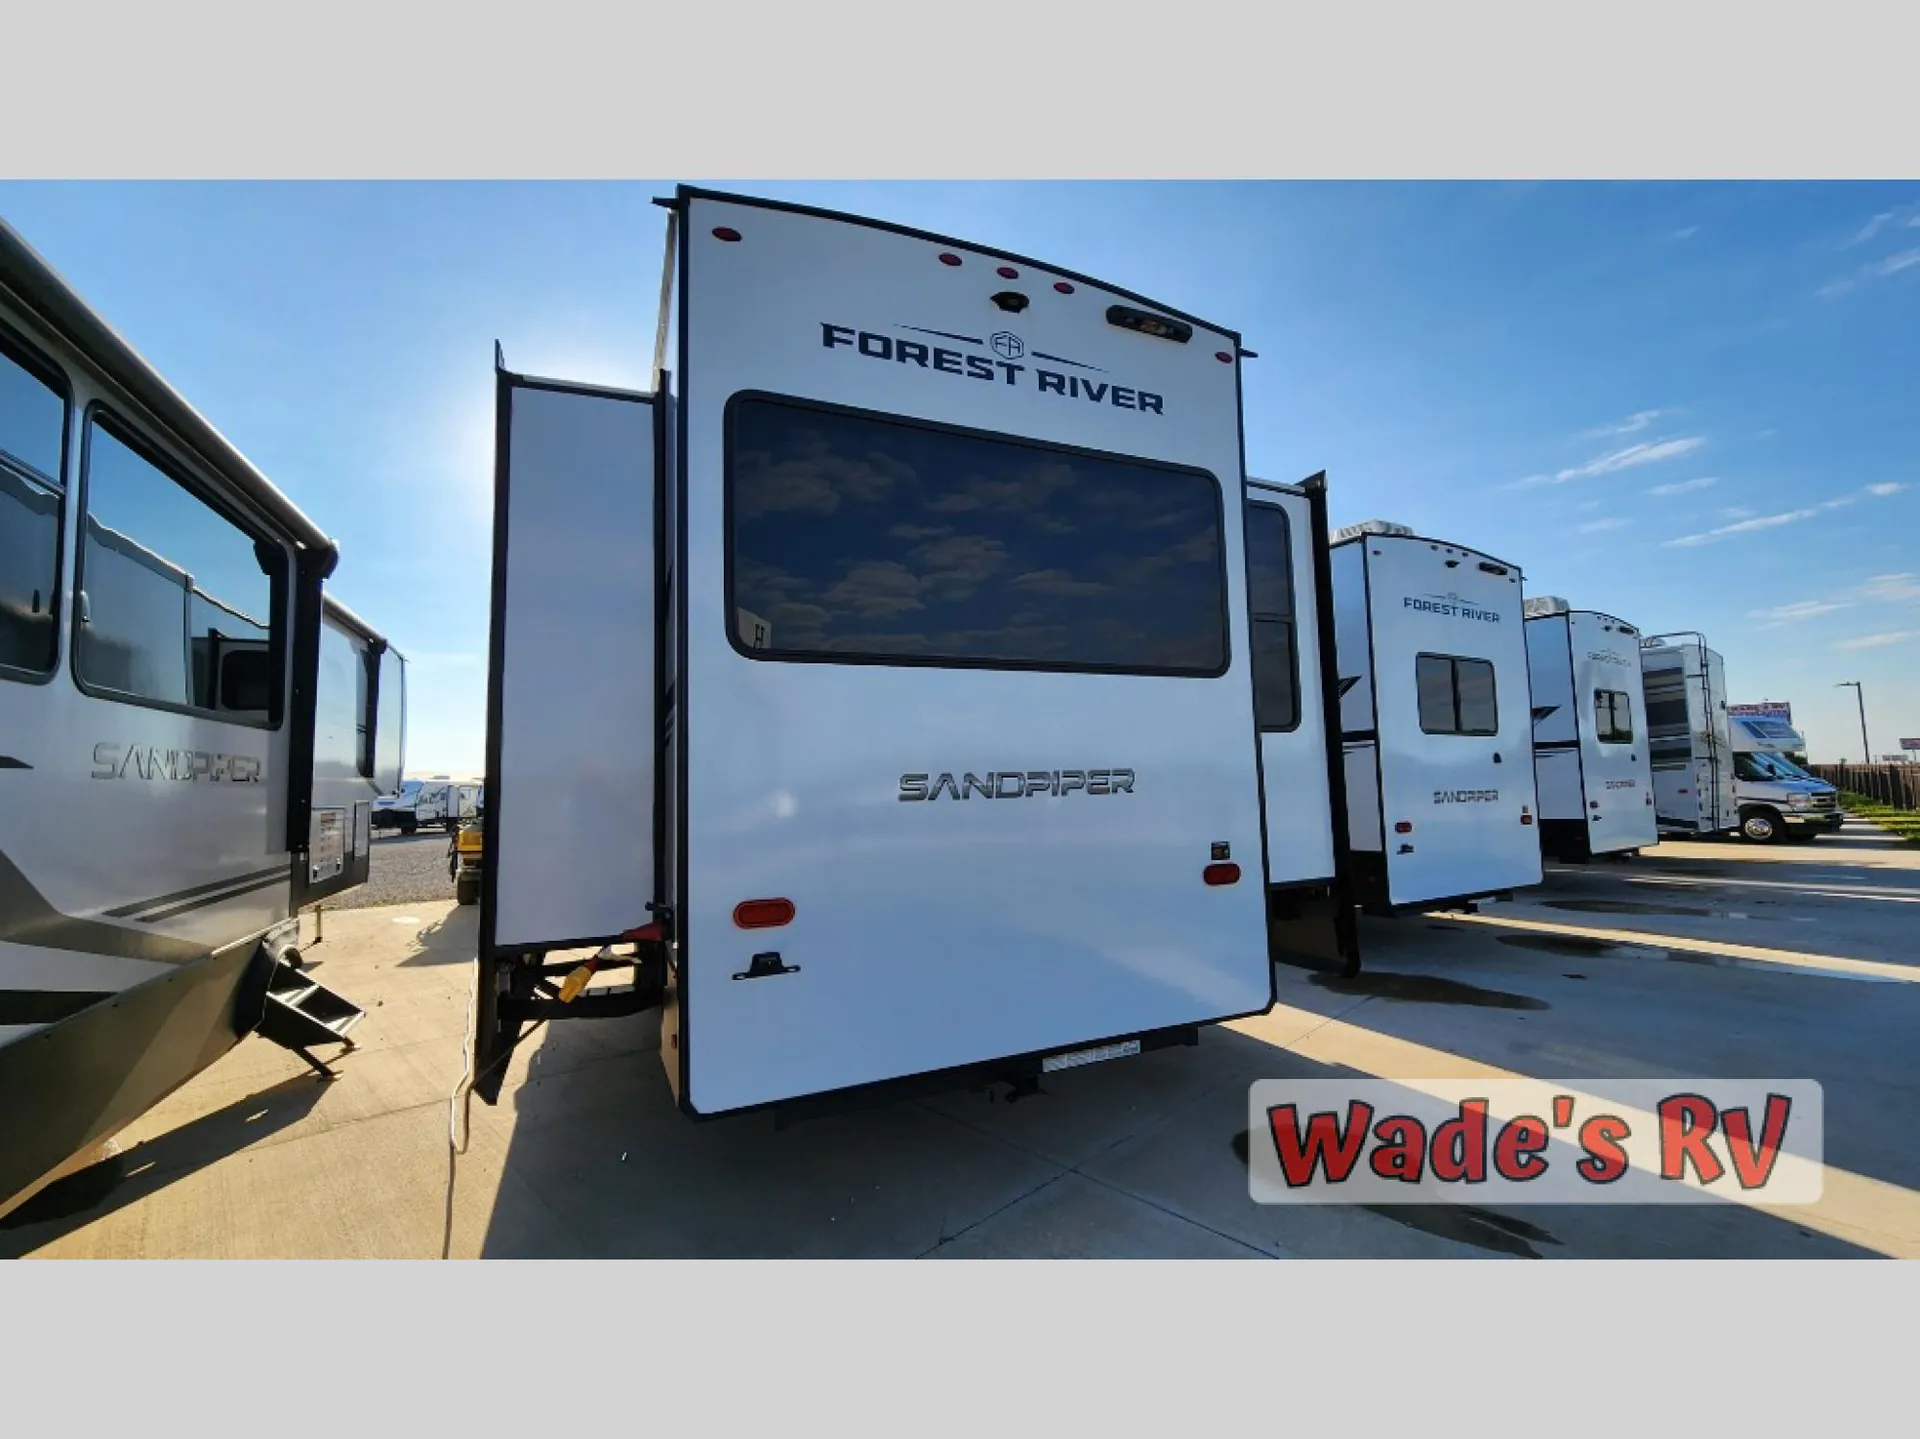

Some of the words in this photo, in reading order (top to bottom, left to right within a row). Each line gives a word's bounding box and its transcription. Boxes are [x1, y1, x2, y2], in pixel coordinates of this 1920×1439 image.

[820, 322, 1025, 386] FOREST
[1036, 368, 1164, 415] RIVER
[1403, 597, 1458, 616] FOREST
[1462, 607, 1500, 623] RIVER
[91, 741, 261, 783] SANDPIPER
[898, 768, 1135, 801] SANDPIPER
